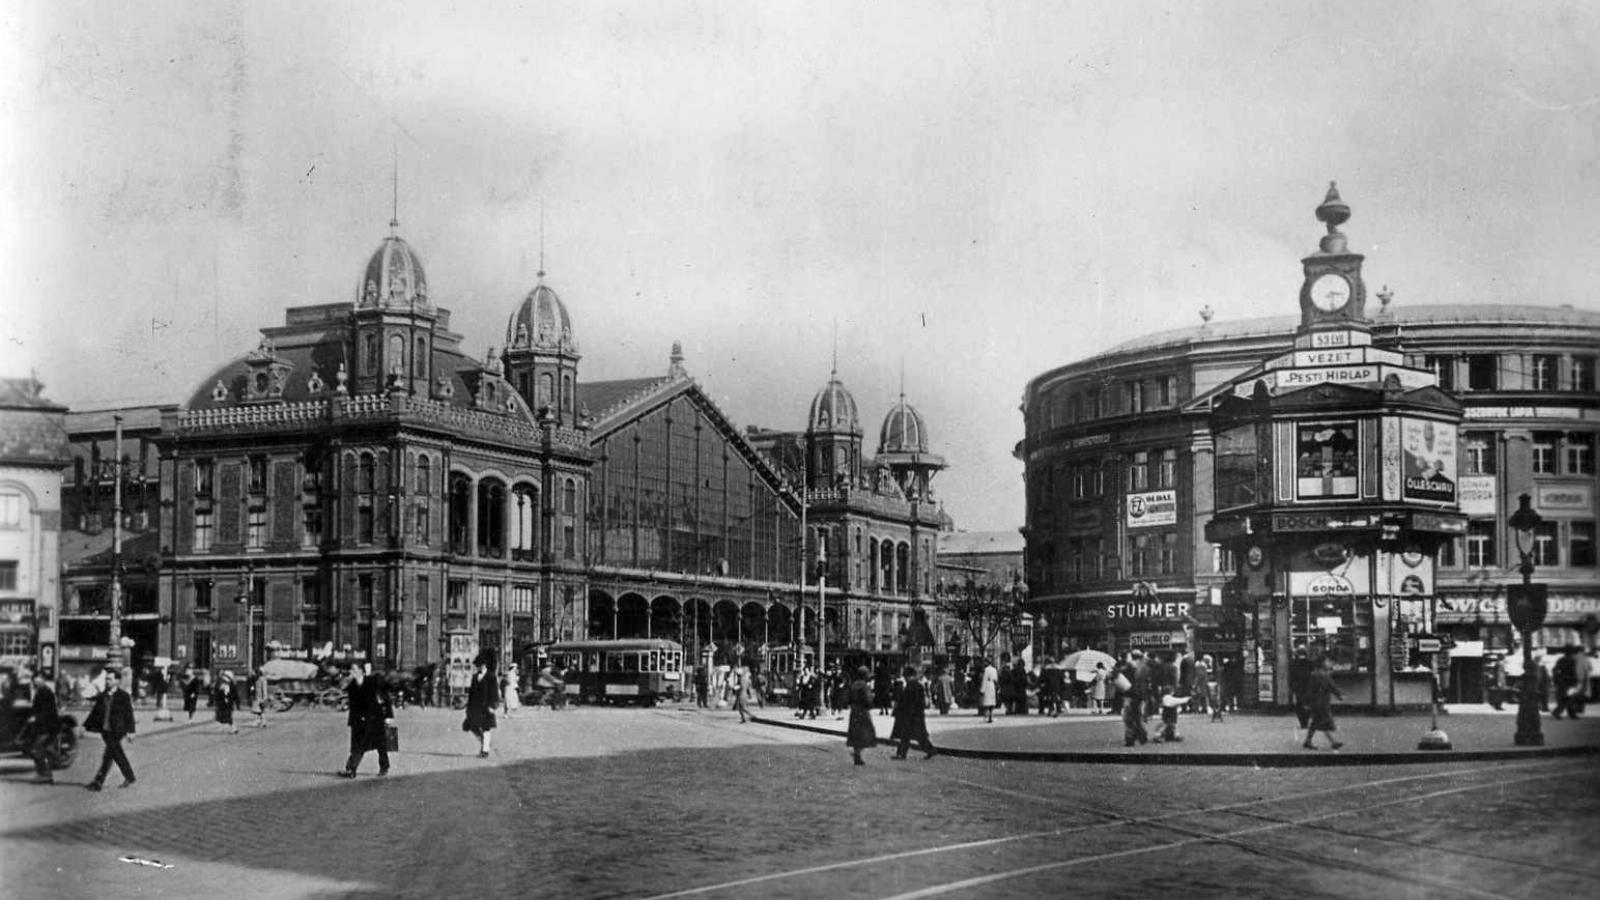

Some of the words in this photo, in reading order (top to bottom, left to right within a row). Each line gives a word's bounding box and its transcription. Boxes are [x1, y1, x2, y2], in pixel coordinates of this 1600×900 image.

[1308, 352, 1352, 363] VEZET
[1277, 516, 1327, 528] BOSCH
[1312, 584, 1350, 593] GONDA
[1107, 601, 1190, 619] STÜHMER
